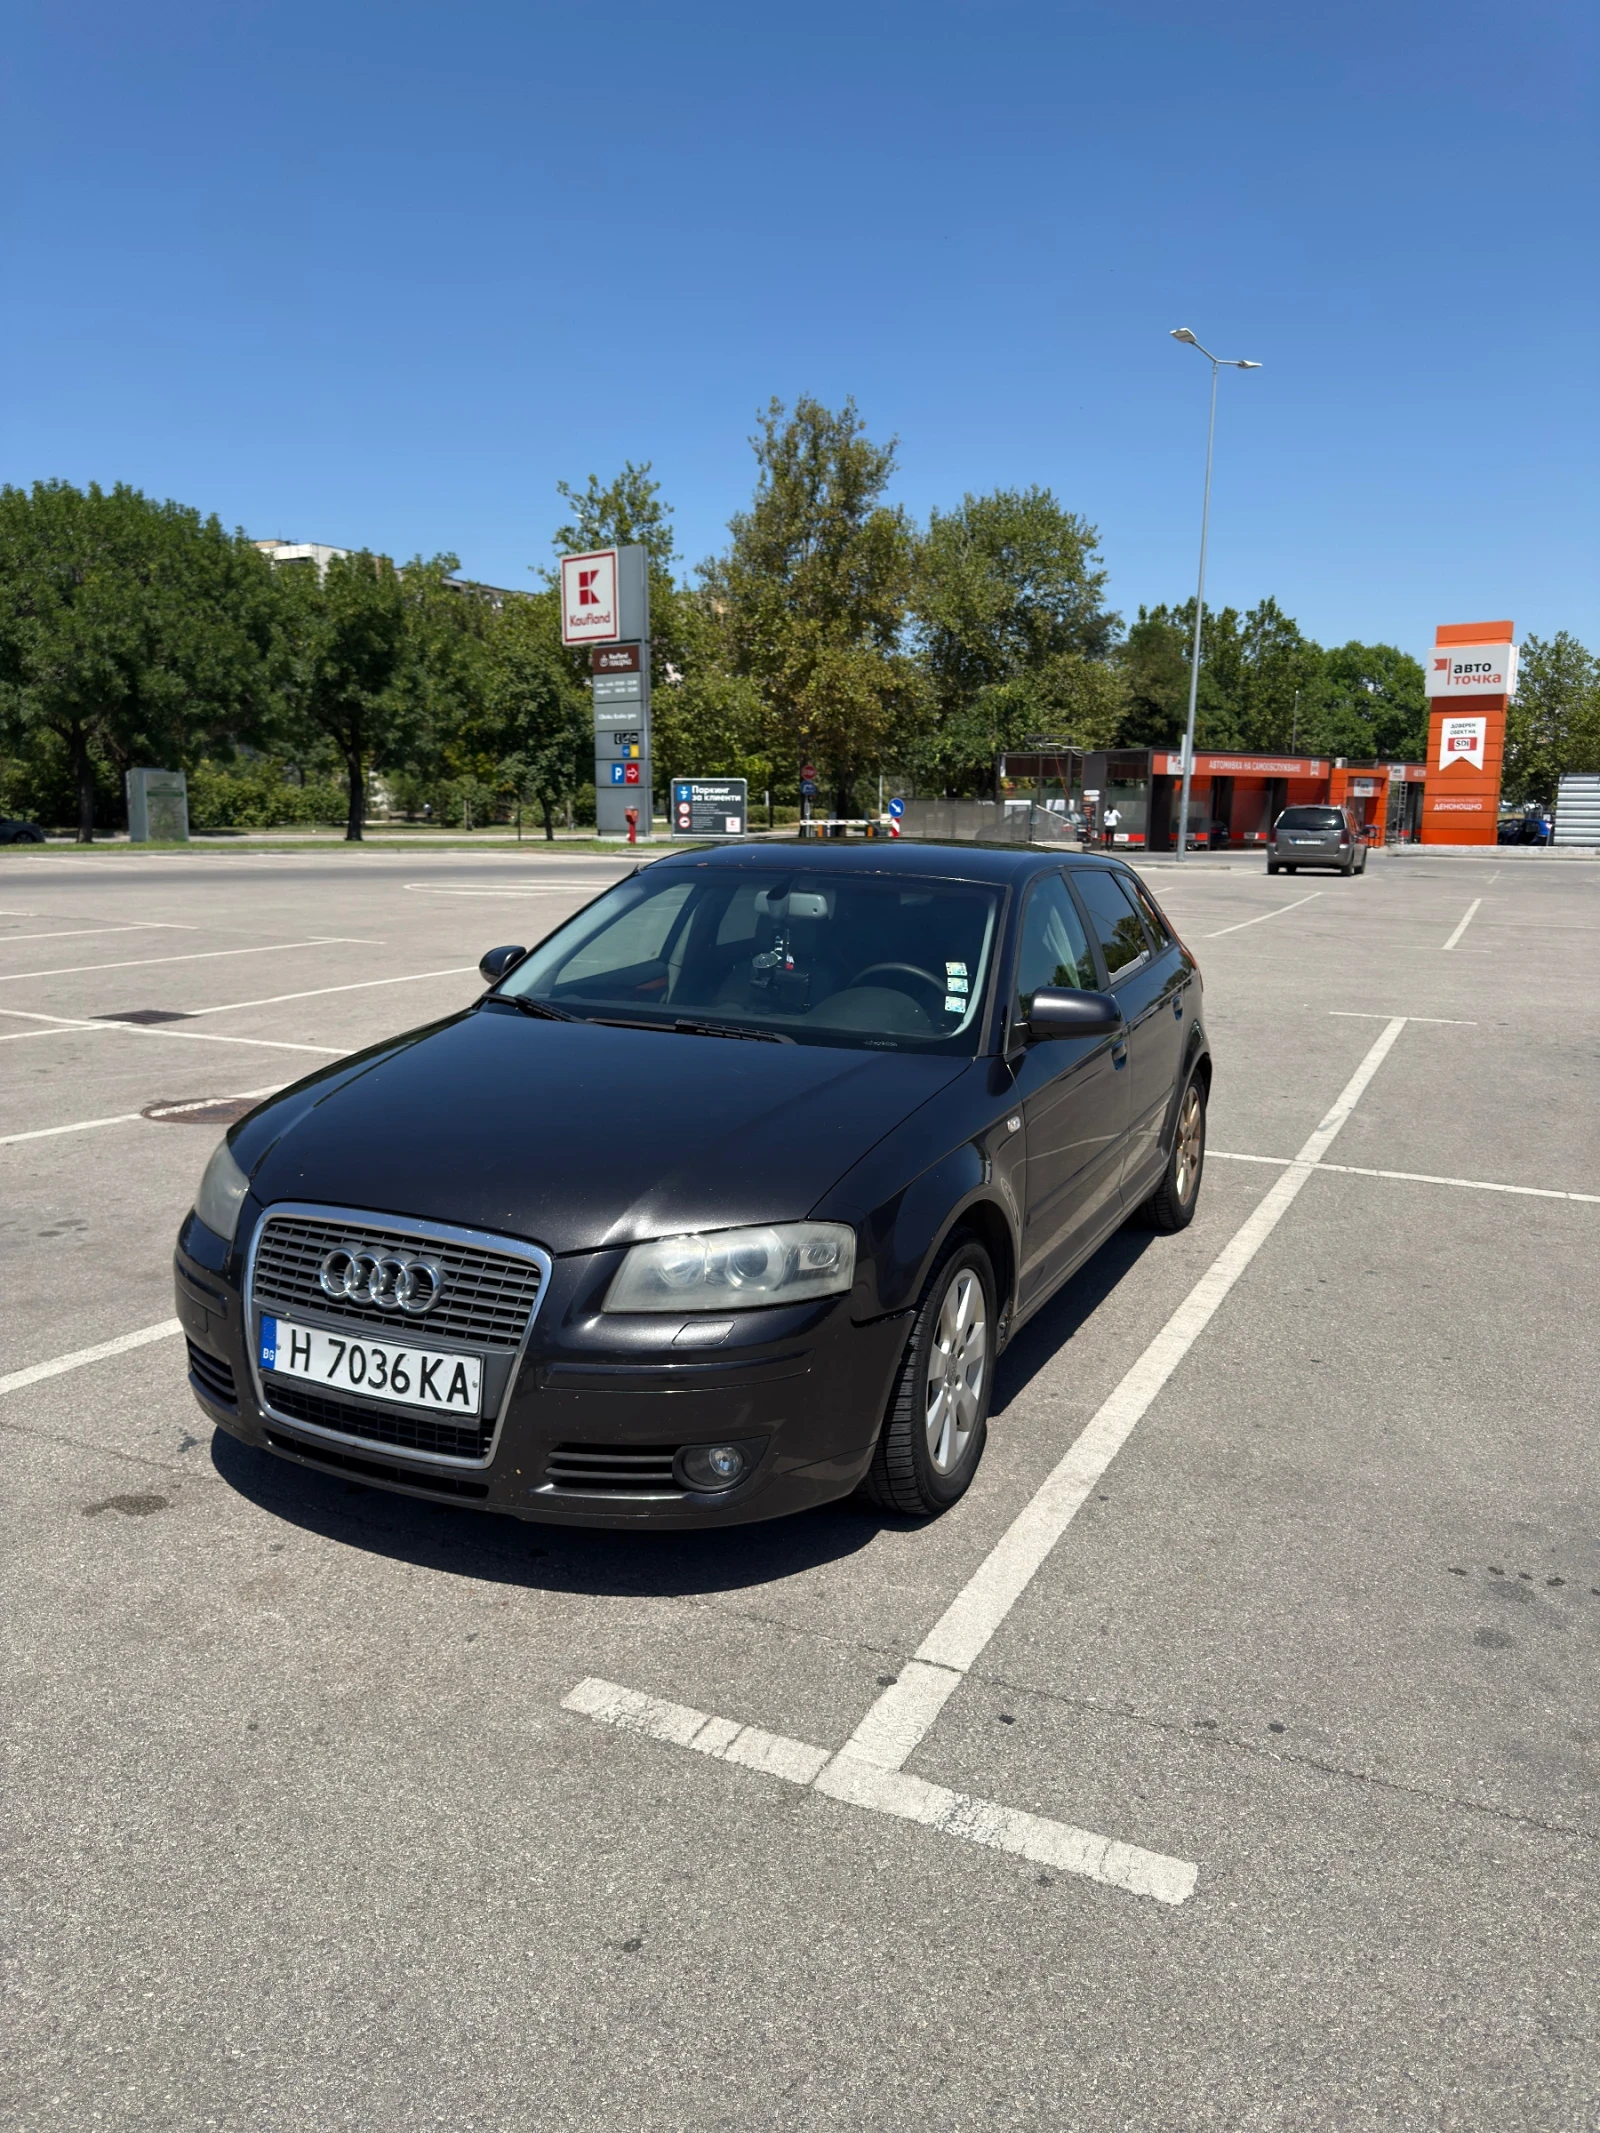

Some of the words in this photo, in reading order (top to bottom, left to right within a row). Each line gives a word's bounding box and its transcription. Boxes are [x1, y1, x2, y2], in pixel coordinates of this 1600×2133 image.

[569, 611, 611, 627] Kaufland
[1453, 662, 1492, 674] авто
[1453, 673, 1502, 685] точка
[1208, 759, 1242, 770] АВТОМИВКА
[1244, 761, 1251, 771] НА
[615, 767, 622, 780] P
[692, 785, 730, 795] Паркинг
[1433, 803, 1482, 811] ДЕНОНОЩНО
[263, 1347, 275, 1361] BG
[290, 1328, 311, 1372] H
[327, 1337, 411, 1394] 7036
[419, 1355, 470, 1406] KA
